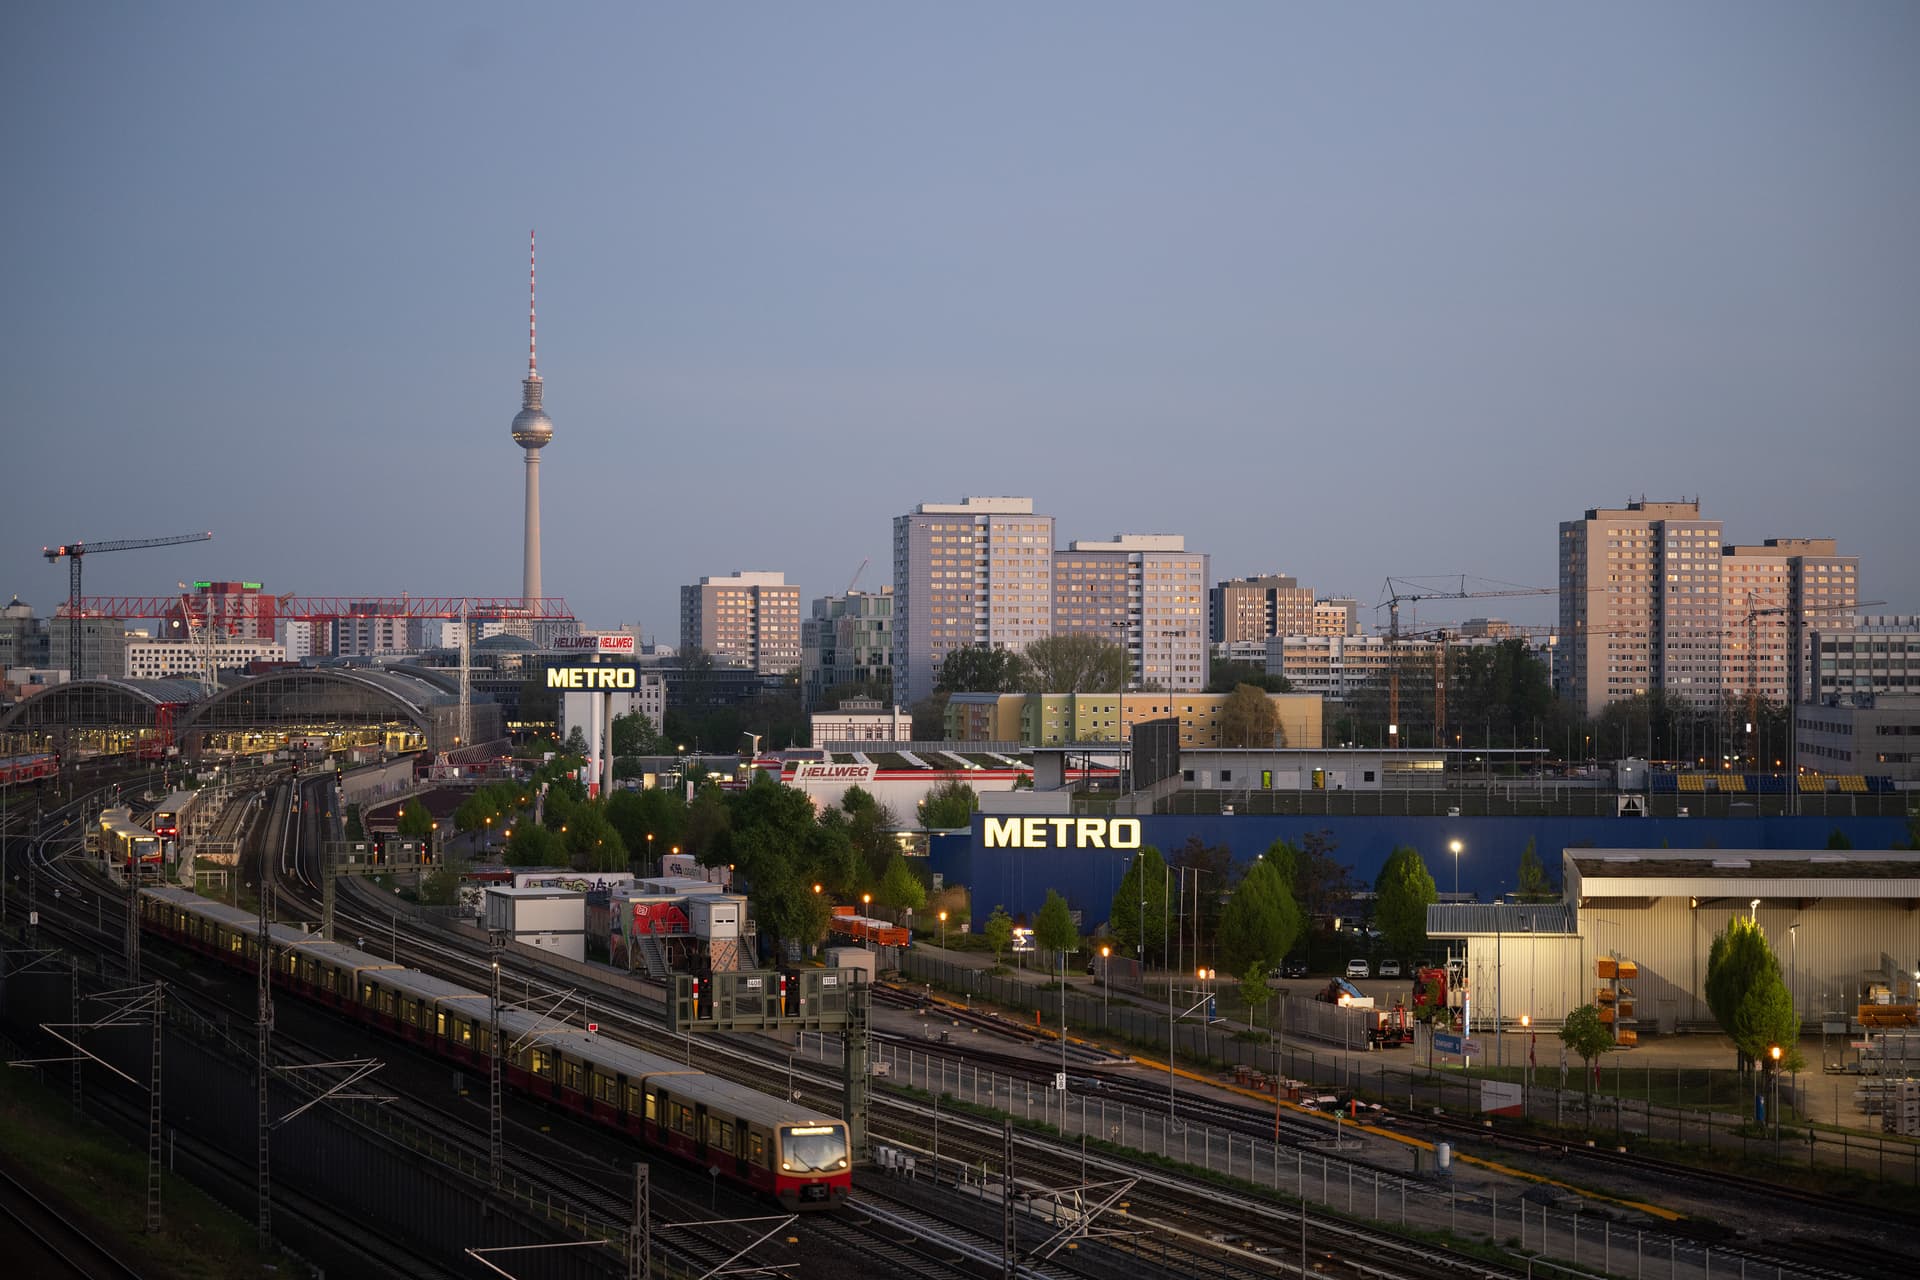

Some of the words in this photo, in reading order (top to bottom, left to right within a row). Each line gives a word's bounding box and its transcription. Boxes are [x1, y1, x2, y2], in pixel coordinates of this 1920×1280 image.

[553, 637, 597, 648] HELLWEG
[600, 637, 633, 648] HELLWEG
[547, 667, 635, 688] METRO
[801, 766, 870, 777] HELLWEG
[984, 817, 1141, 849] METRO
